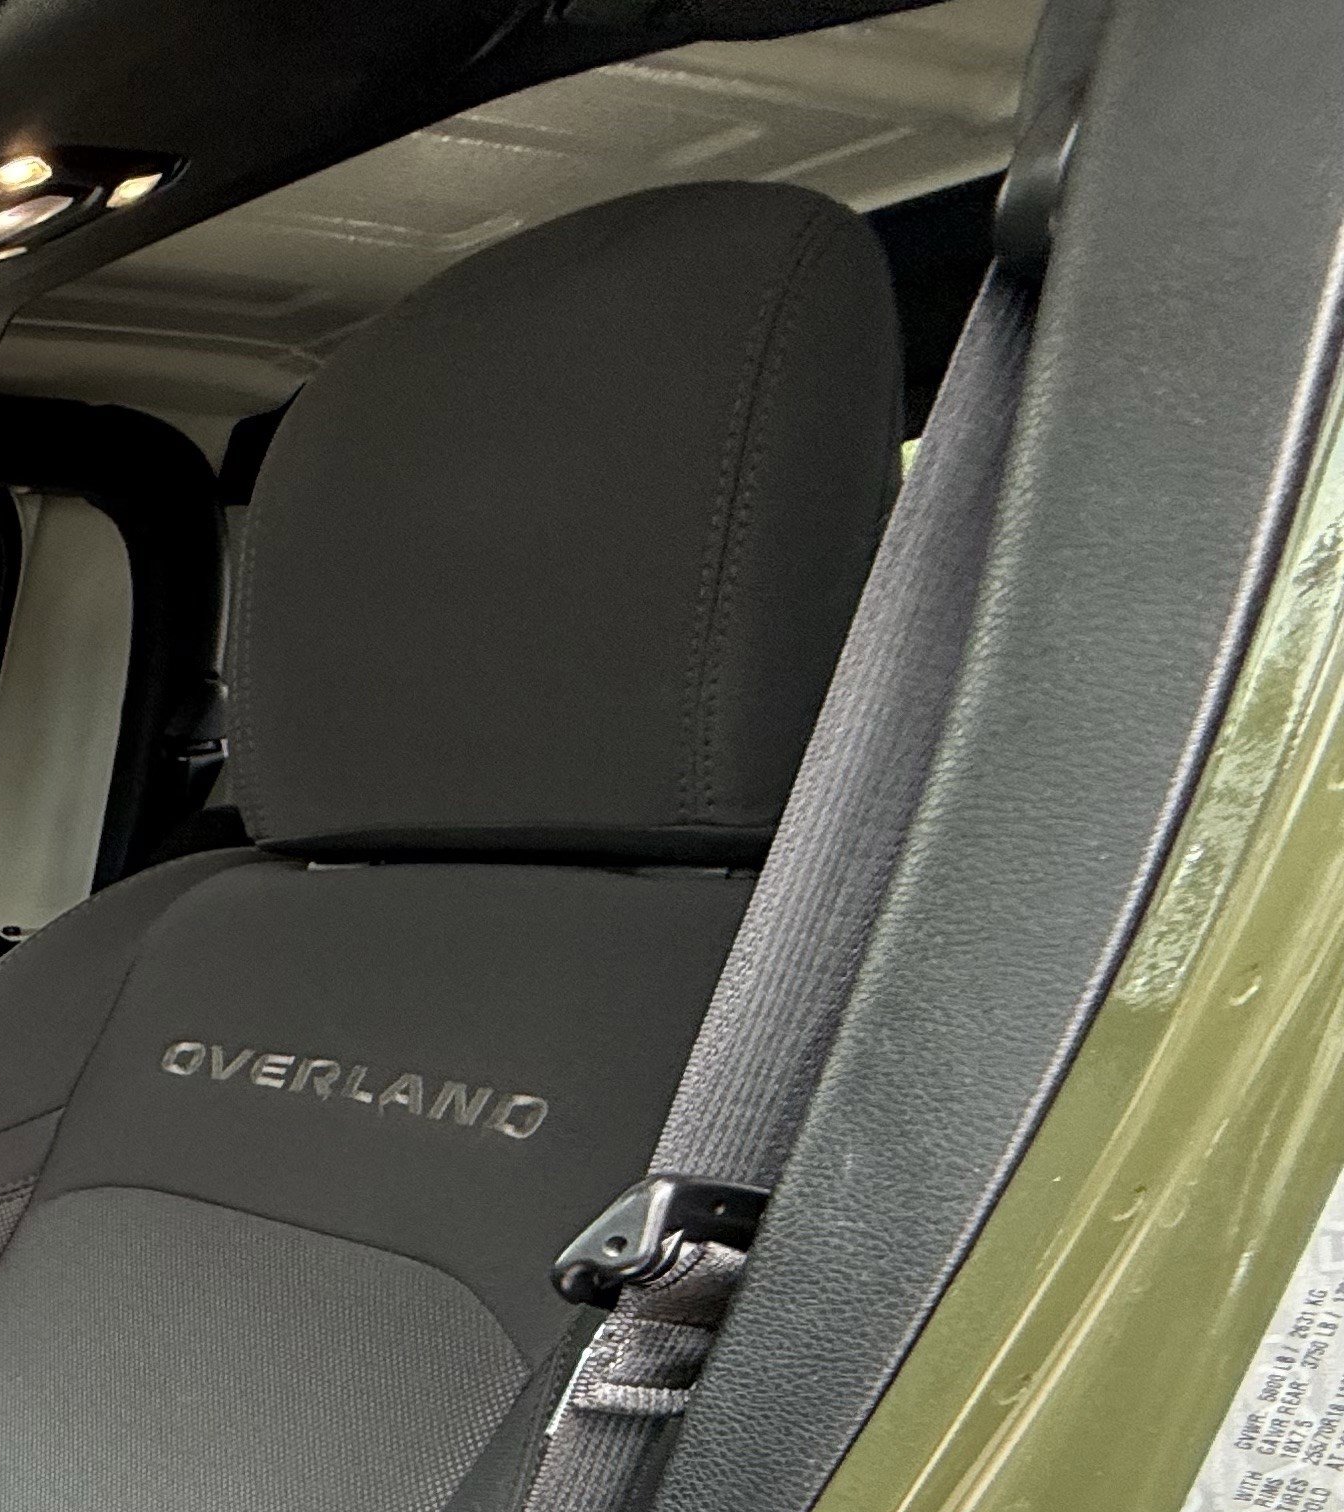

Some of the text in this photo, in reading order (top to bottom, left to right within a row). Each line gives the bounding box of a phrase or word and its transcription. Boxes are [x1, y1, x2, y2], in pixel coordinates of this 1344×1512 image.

[161, 1040, 549, 1139] OVERLAND
[1303, 1288, 1328, 1307] KG
[1233, 1470, 1263, 1501] WITH
[1254, 1478, 1284, 1508] RIMS
[1275, 1478, 1309, 1511] TIRES
